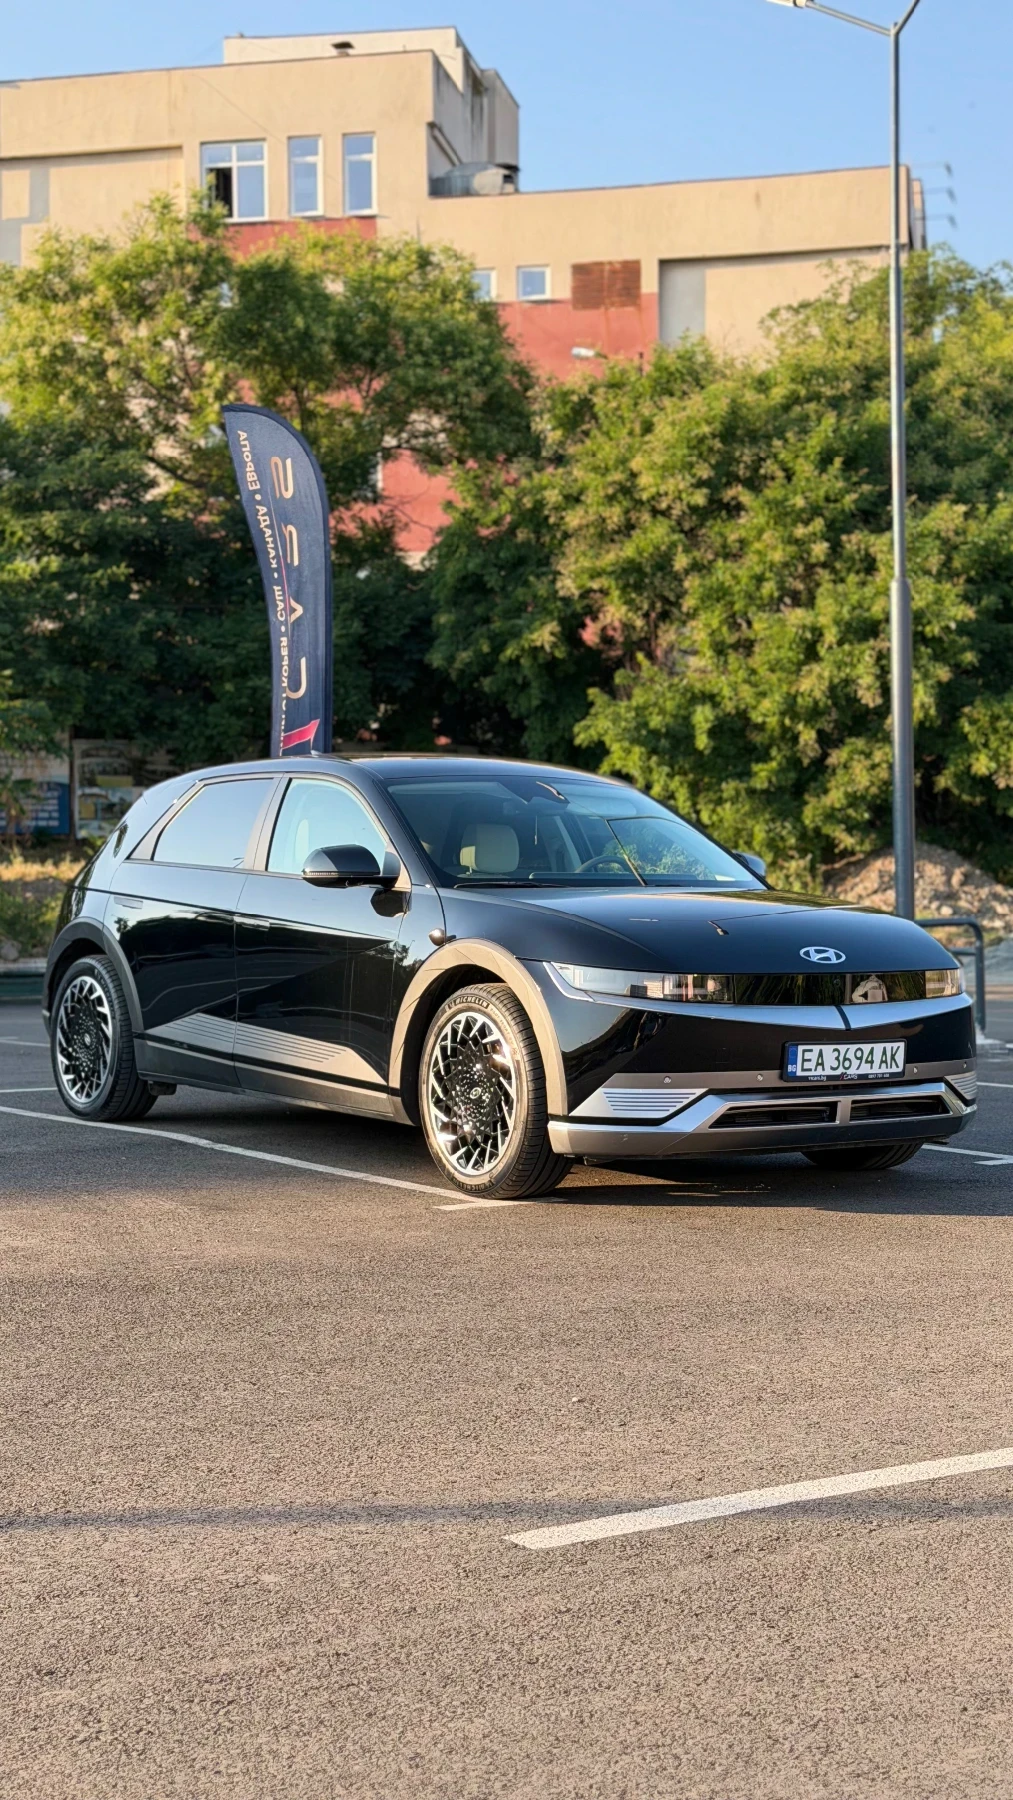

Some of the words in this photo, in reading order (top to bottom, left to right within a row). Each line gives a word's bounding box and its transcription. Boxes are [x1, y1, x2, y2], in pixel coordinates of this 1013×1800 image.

[456, 996, 488, 1008] MICHELIN
[801, 1049, 825, 1072] EA
[830, 1047, 875, 1071] 3694
[879, 1046, 900, 1069] AK
